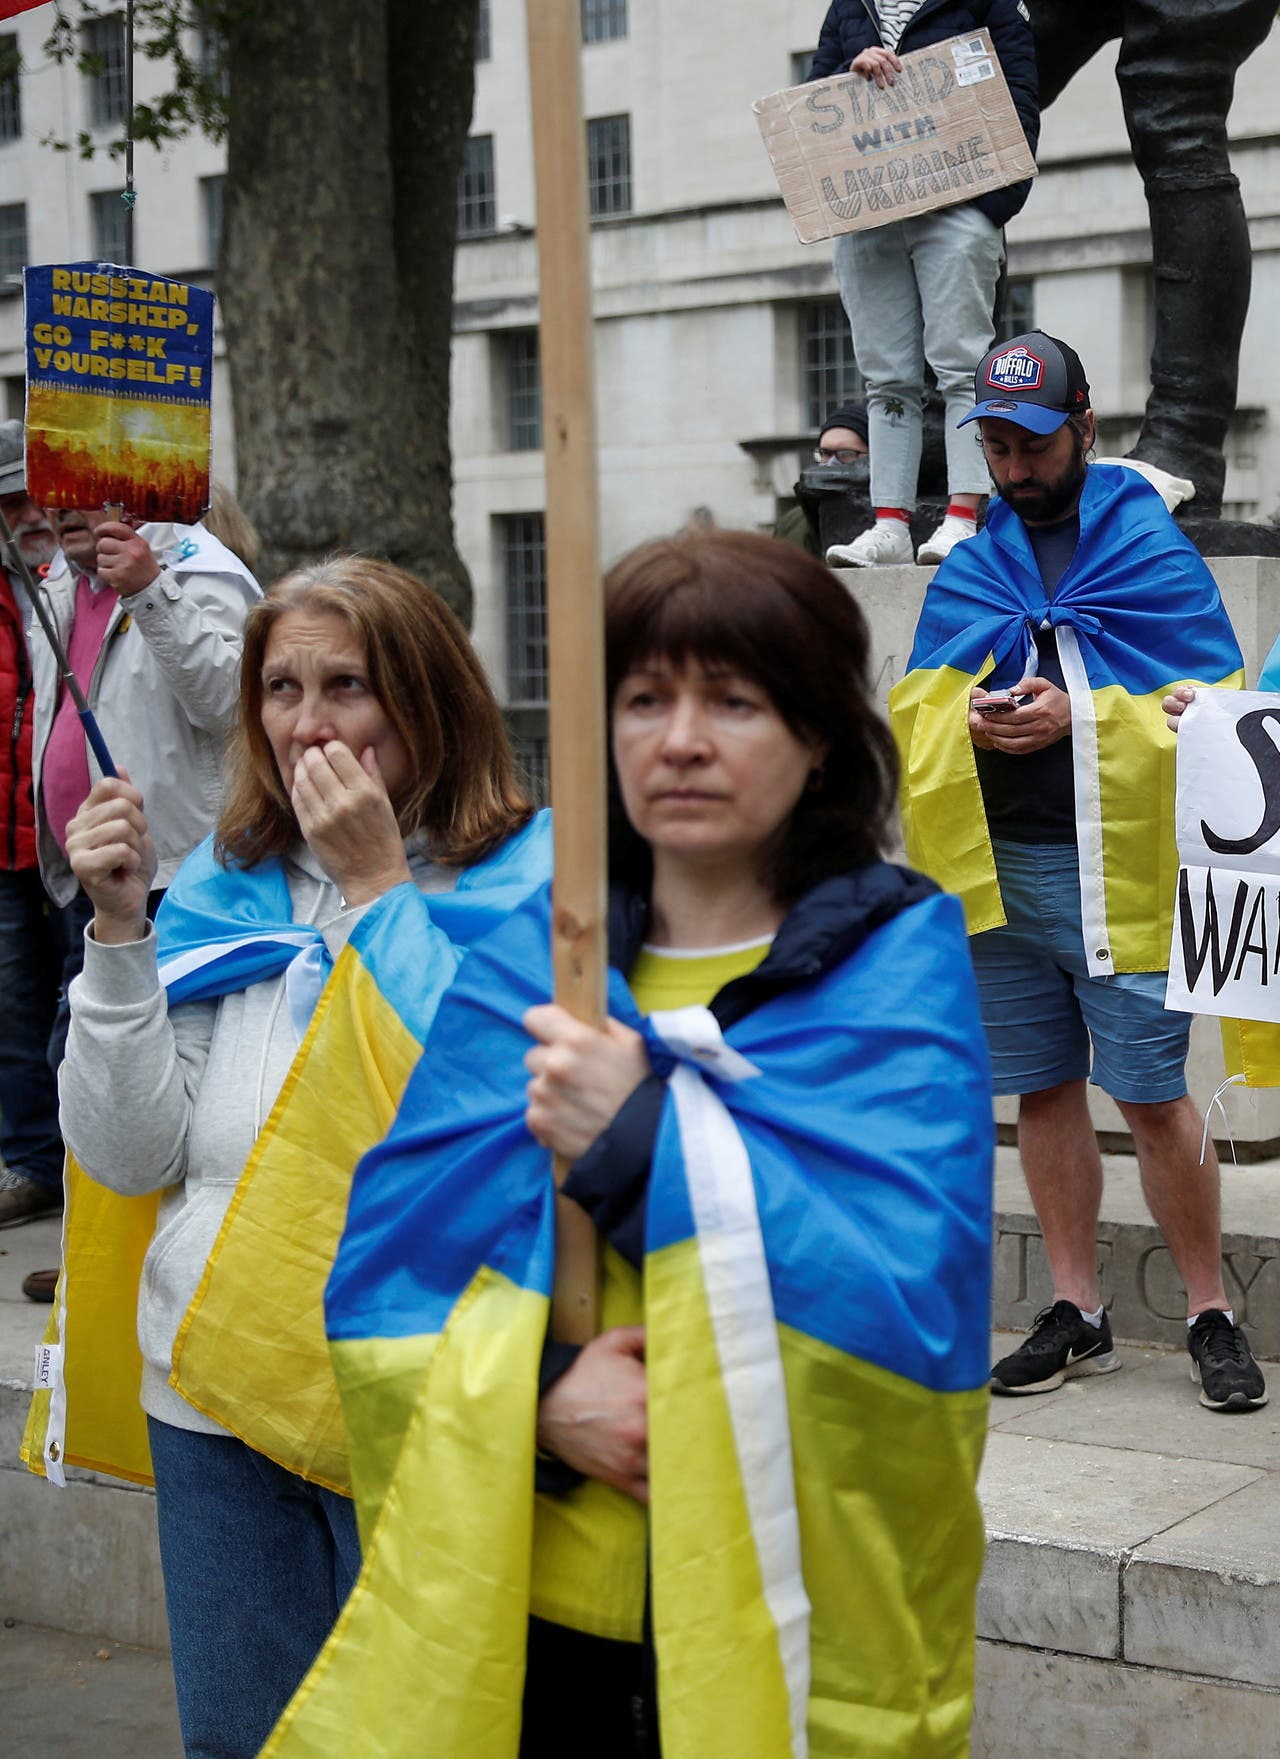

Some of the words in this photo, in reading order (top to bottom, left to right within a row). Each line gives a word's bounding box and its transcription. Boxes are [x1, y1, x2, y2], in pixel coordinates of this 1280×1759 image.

[805, 57, 955, 134] STAND
[851, 115, 937, 152] WITH
[821, 136, 994, 219] UKRAINE
[52, 269, 188, 305] RUSSIAN
[52, 294, 199, 336] WARSHIP,
[33, 323, 72, 346] GO
[34, 347, 203, 387] YOURSELF!
[995, 357, 1034, 377] BUFFALO
[1004, 375, 1018, 384] BILLS
